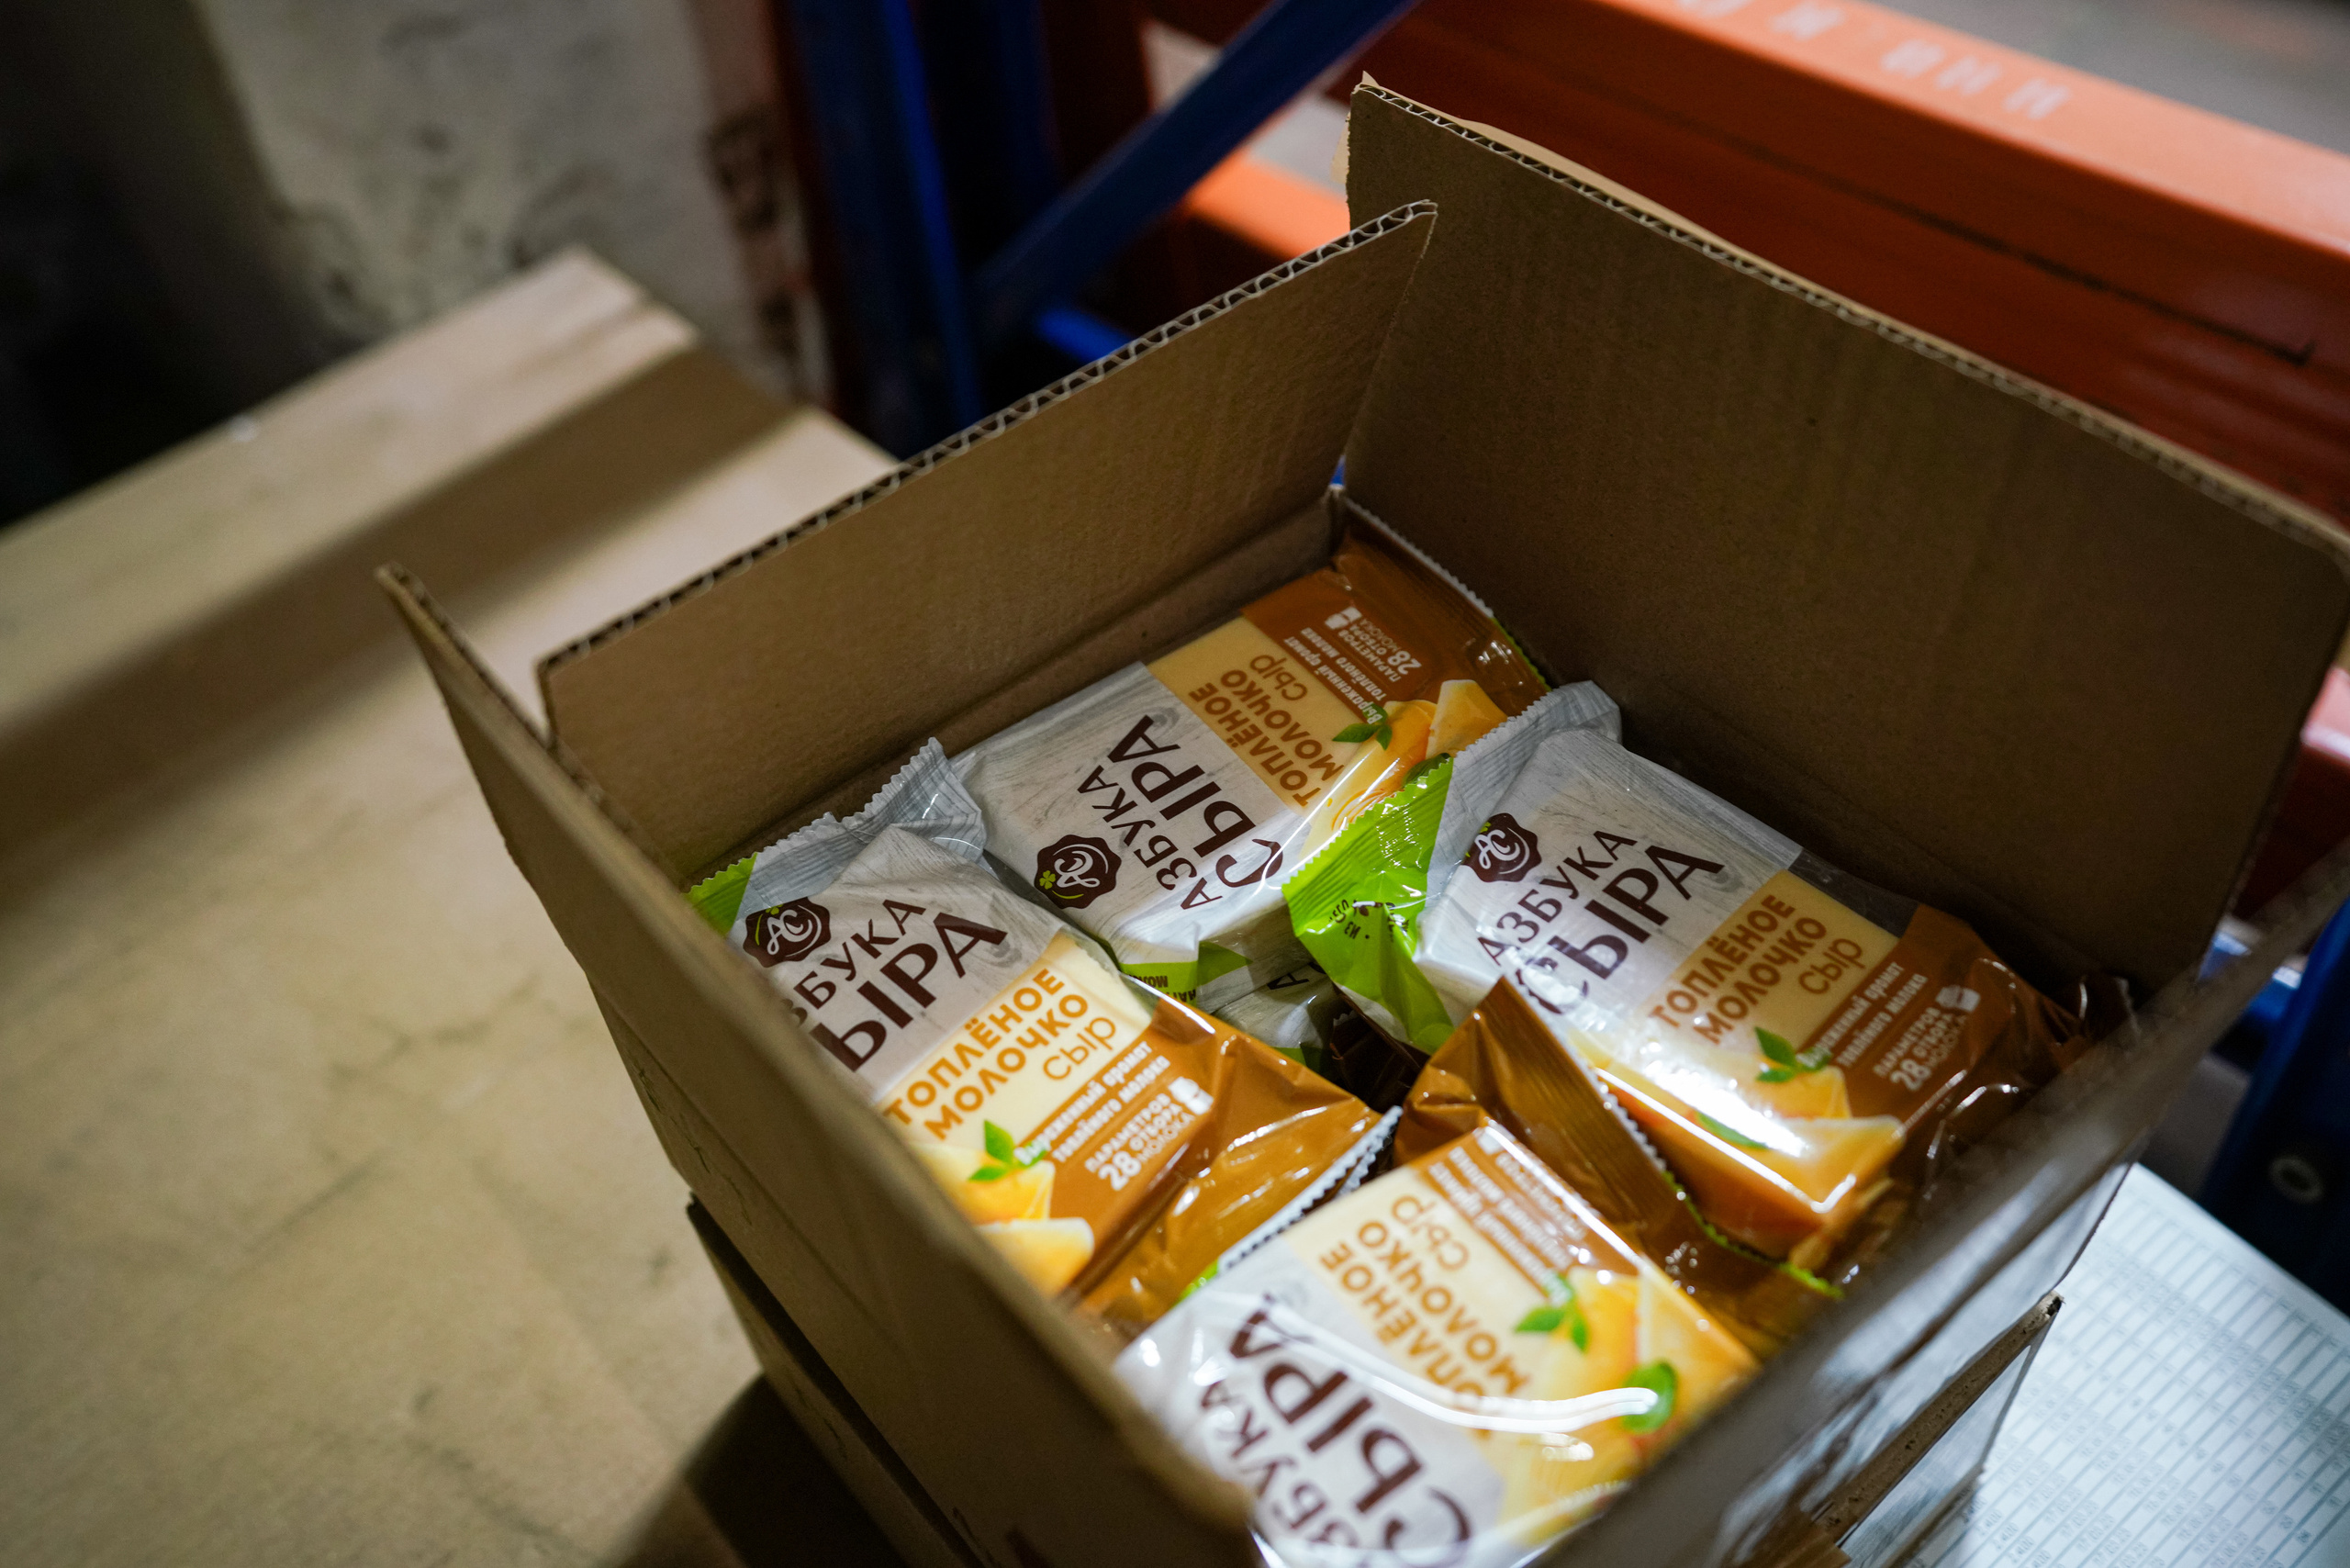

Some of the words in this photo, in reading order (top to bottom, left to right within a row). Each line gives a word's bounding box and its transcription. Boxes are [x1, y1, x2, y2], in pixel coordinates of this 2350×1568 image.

[1314, 664, 1382, 724] Выраженный
[1337, 629, 1402, 682] ПАРАМЕТРОВ
[1348, 623, 1388, 655] ОТБОРА
[1387, 650, 1422, 676] 28
[1189, 682, 1321, 807] ТОПЛЁНОЕ
[1220, 669, 1345, 781] МОЛОЧКО
[1077, 765, 1223, 910] АЗБУКА
[1107, 715, 1283, 888] СЫРА
[1477, 830, 1638, 967] АЗБУКА
[1649, 894, 1796, 1028] ТОПЛЁНОЕ
[809, 912, 1008, 1073] ЫРА
[1693, 918, 1826, 1045] МОЛОЧКО
[881, 968, 1066, 1126] ТОПЛЁНОЕ
[923, 994, 1089, 1141] МОЛОЧКО
[1890, 1058, 1931, 1092] 28
[1098, 1150, 1142, 1191] 28
[1358, 1220, 1531, 1395] МОЛОЧКО
